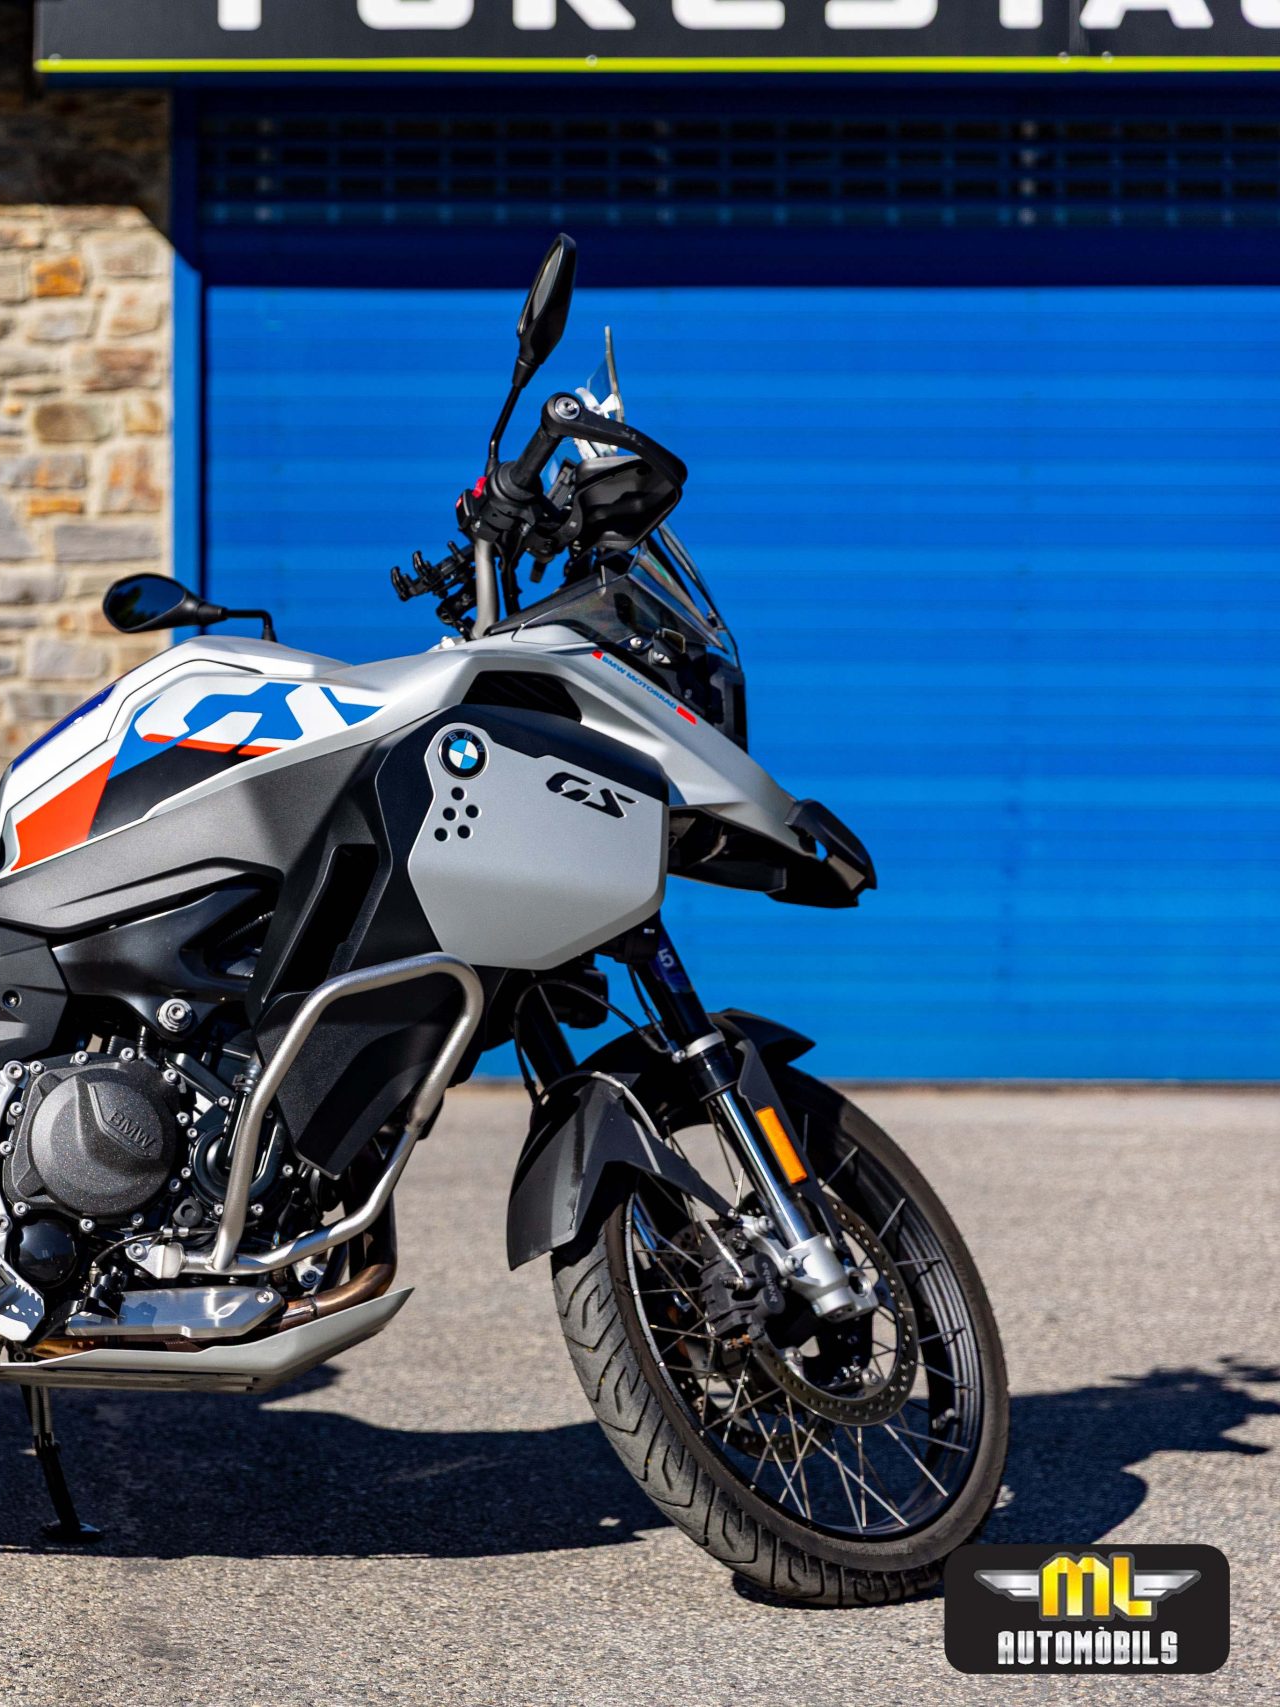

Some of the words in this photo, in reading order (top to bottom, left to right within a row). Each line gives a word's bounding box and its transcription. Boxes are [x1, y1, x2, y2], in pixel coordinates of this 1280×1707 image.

[602, 655, 625, 674] BMW
[626, 671, 677, 710] MOTORRAD
[545, 771, 639, 819] GS
[109, 1110, 157, 1149] BMW
